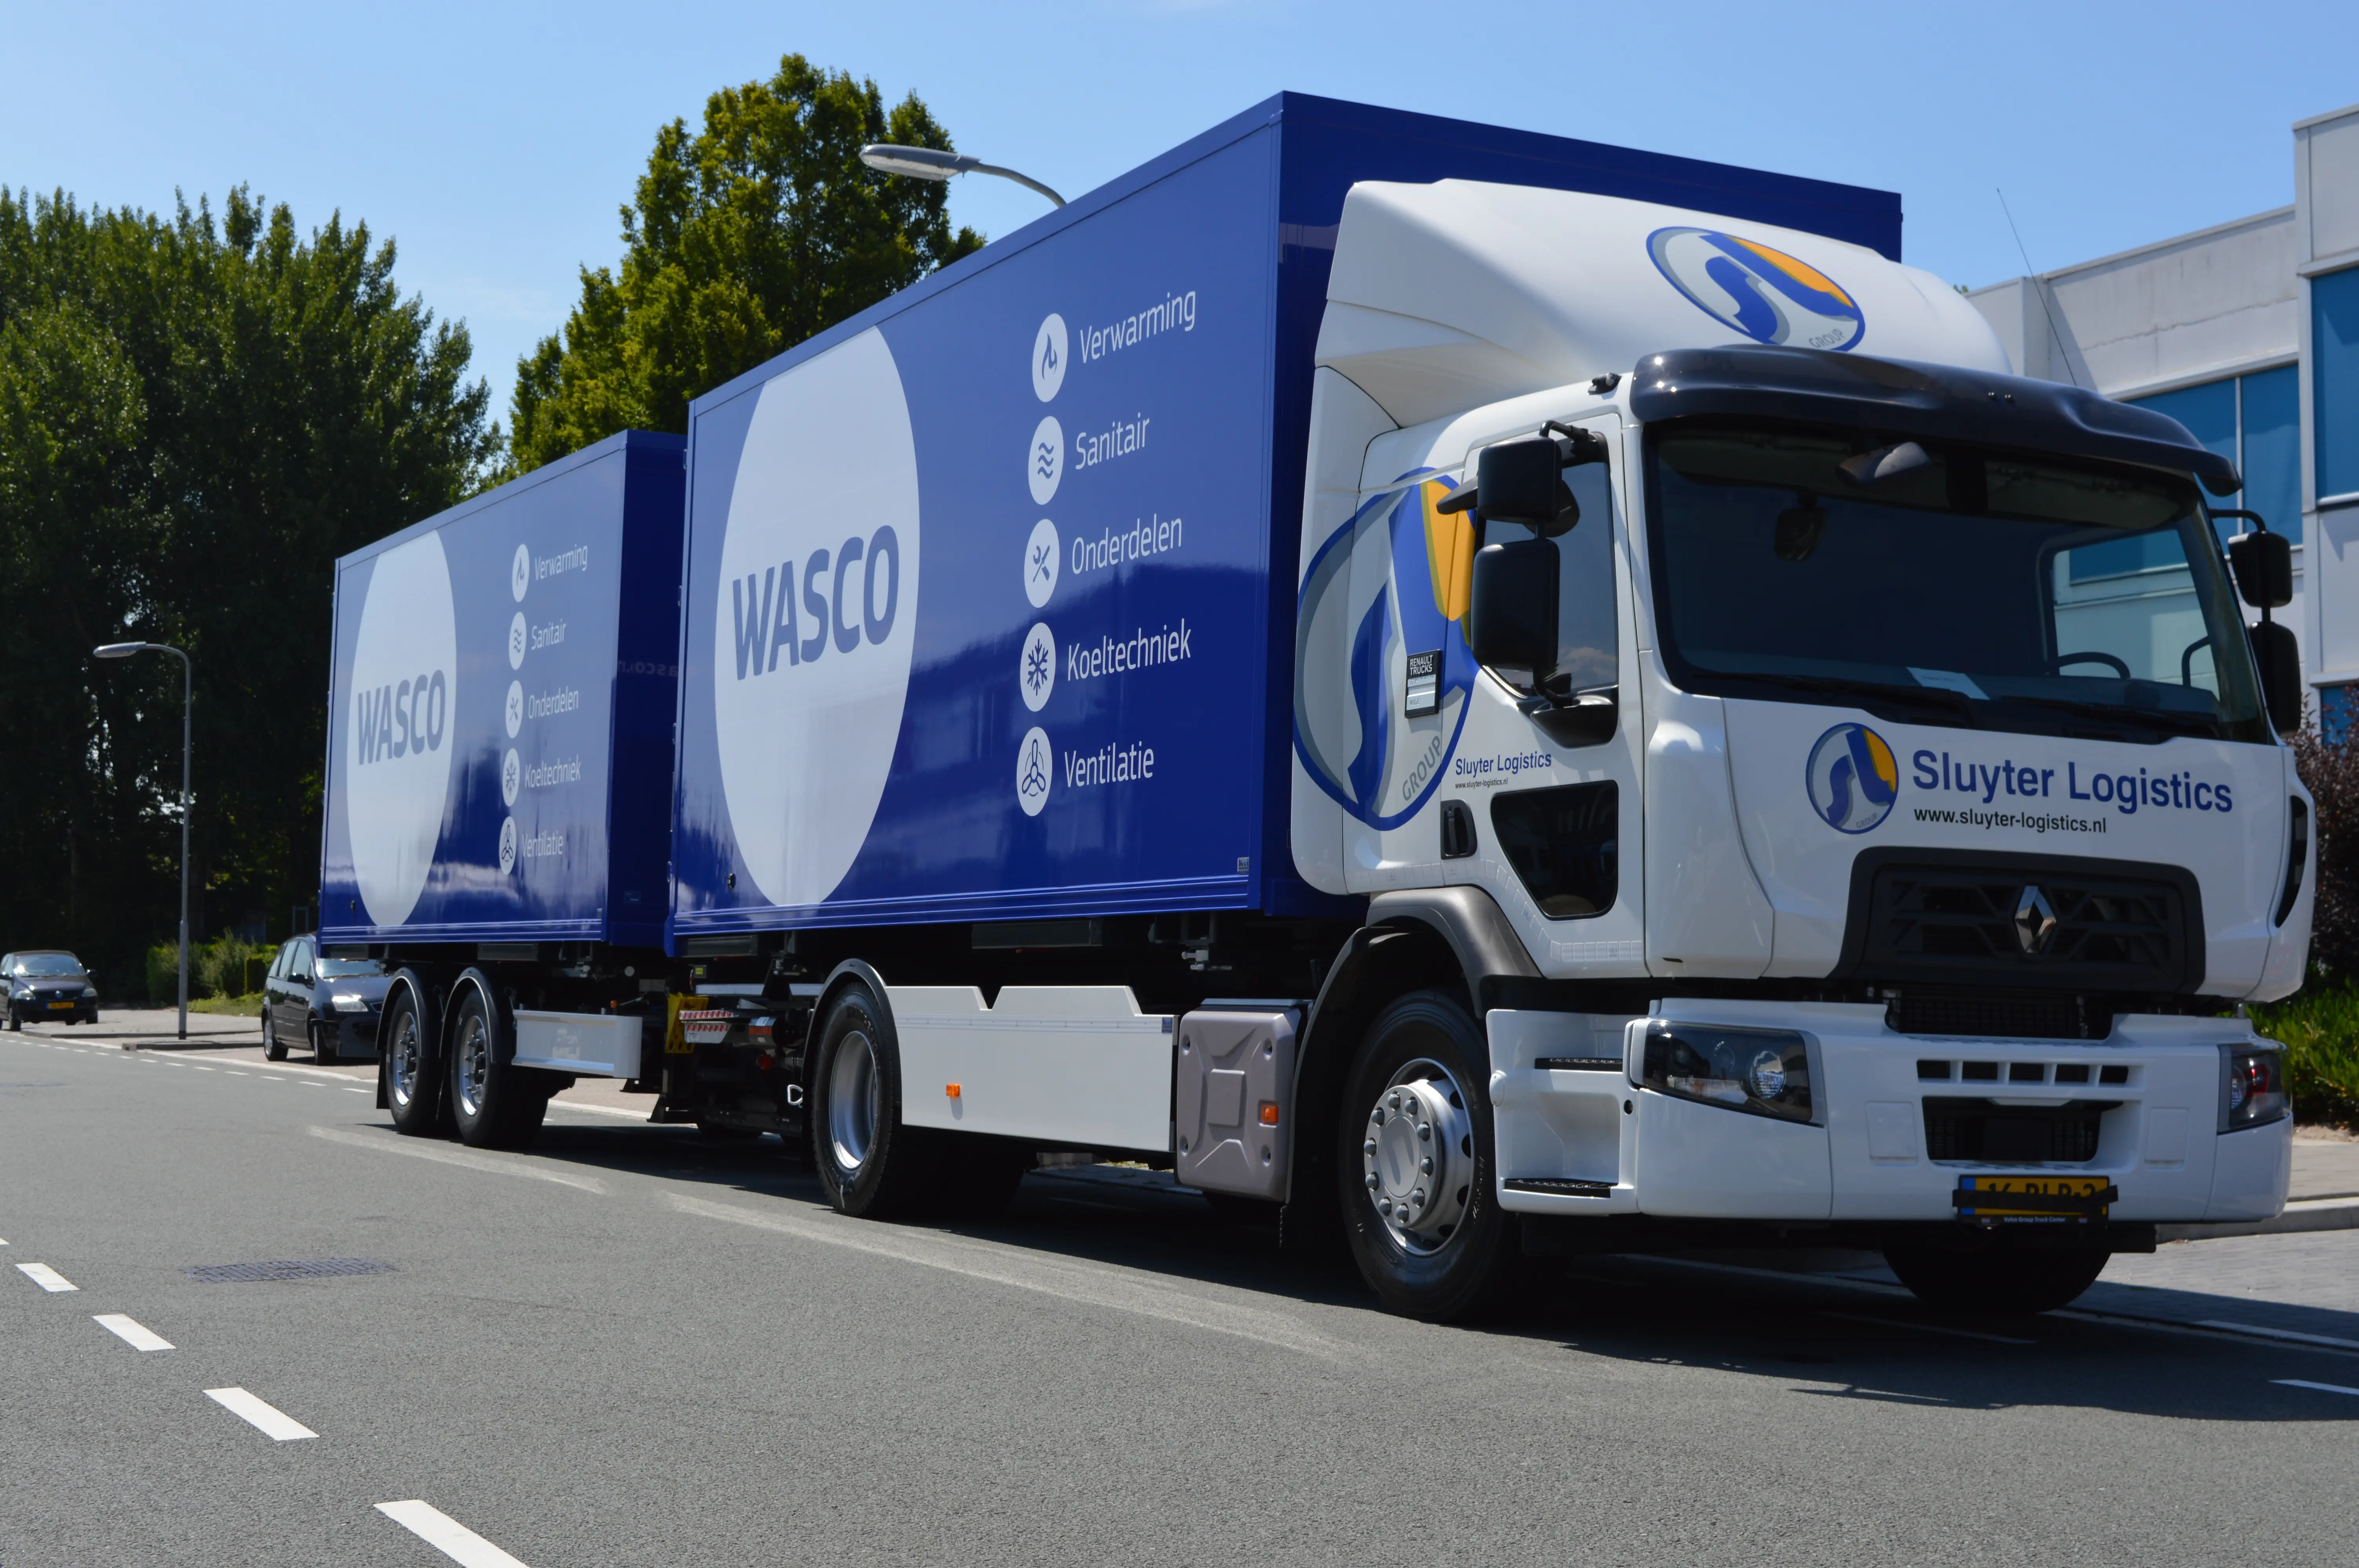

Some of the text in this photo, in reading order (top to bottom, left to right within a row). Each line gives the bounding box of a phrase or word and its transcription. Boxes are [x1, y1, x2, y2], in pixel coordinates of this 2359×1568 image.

[1080, 291, 1196, 363] Verwarming
[1808, 328, 1845, 348] GROUP
[1076, 412, 1150, 470] Sanitair
[1072, 513, 1182, 574] Onderdelen
[535, 544, 588, 580] Verwarming
[732, 525, 899, 681] WASCO
[531, 619, 566, 650] Sanitair
[1068, 618, 1191, 681] Koeltechniek
[1410, 655, 1433, 667] RENAULT
[1410, 664, 1433, 676] TRUCKS
[358, 670, 445, 765] WASCO
[529, 685, 579, 719] Onderdelen
[525, 755, 581, 788] Koeltechniek
[1065, 741, 1154, 788] Ventilatie
[1402, 735, 1441, 801] GROUP
[1455, 751, 1552, 778] Sluyter Logistics
[1455, 778, 1508, 789] www.sluyter-logistics.nl
[1913, 750, 2232, 814] Sluyter Logistics
[1856, 813, 1877, 829] GROUP
[1914, 808, 2106, 833] www.sluyter-logistics.nl
[522, 831, 563, 857] Ventilatie
